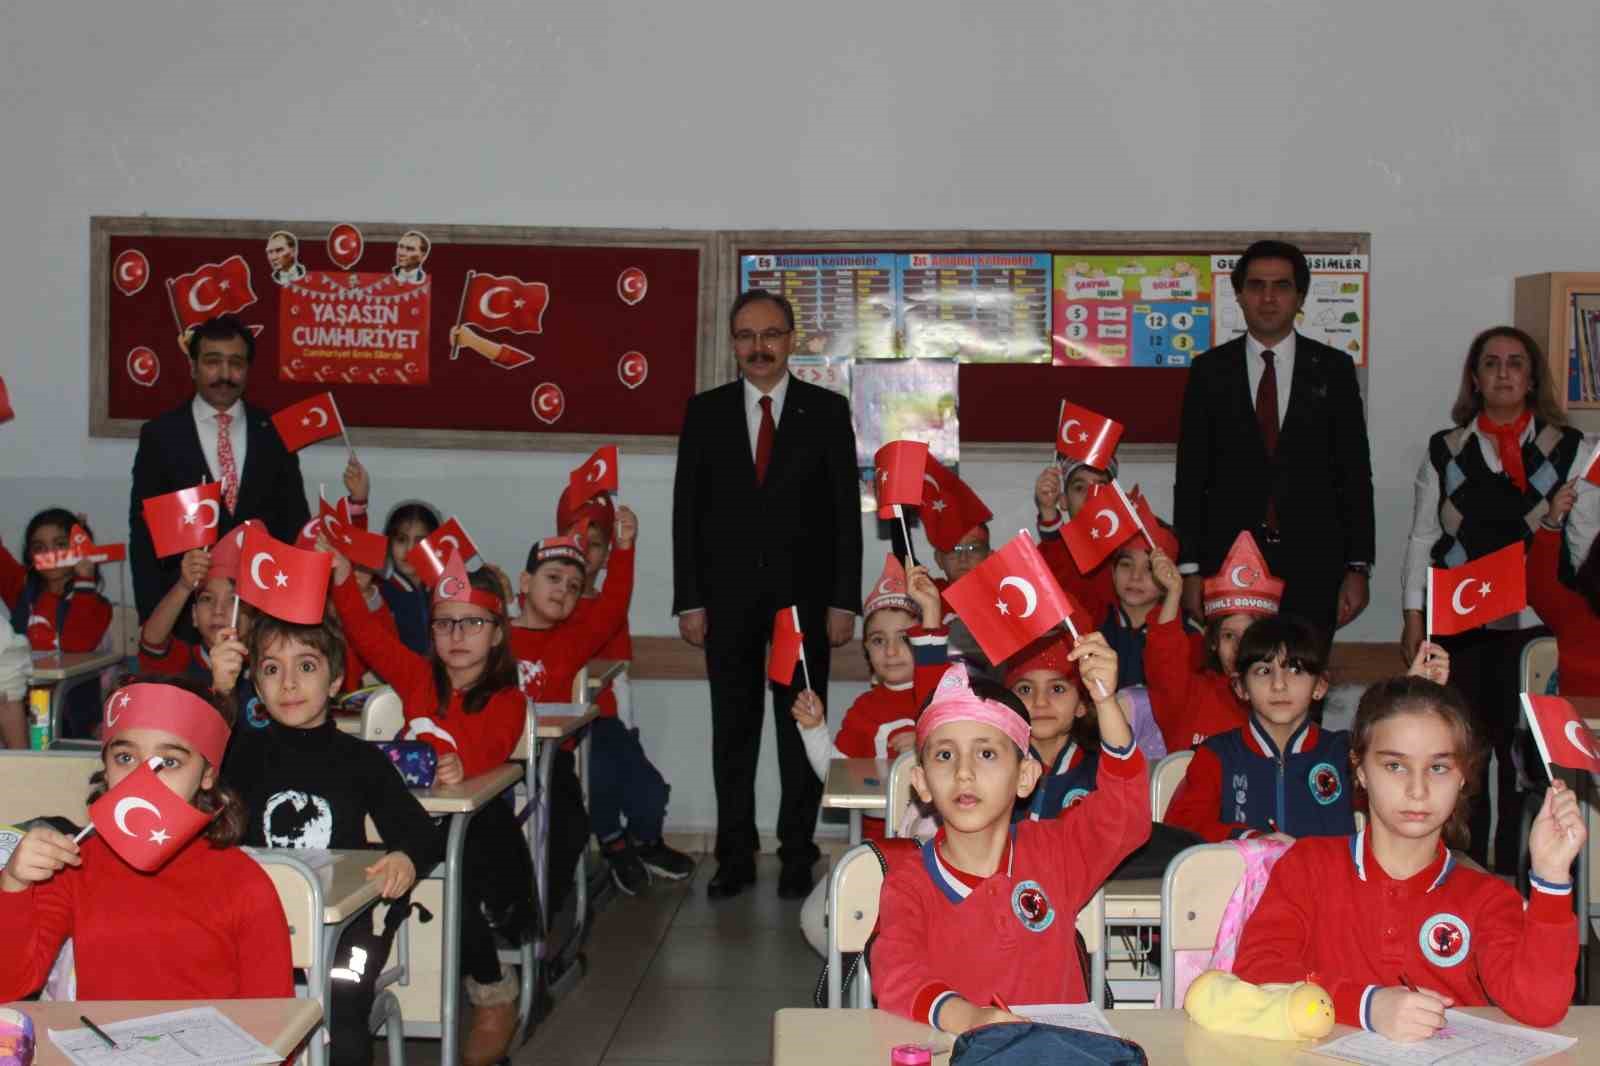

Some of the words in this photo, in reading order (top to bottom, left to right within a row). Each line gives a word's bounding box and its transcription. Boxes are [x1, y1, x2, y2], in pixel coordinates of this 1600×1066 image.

[1305, 257, 1362, 269] İSİMLER
[311, 303, 399, 325] YAŞASIN
[1074, 308, 1081, 319] 5
[1150, 316, 1163, 327] 12
[1178, 316, 1187, 327] 4
[292, 325, 420, 349] CUMHURİYET
[1073, 326, 1081, 337] 3
[1180, 337, 1188, 347] 3
